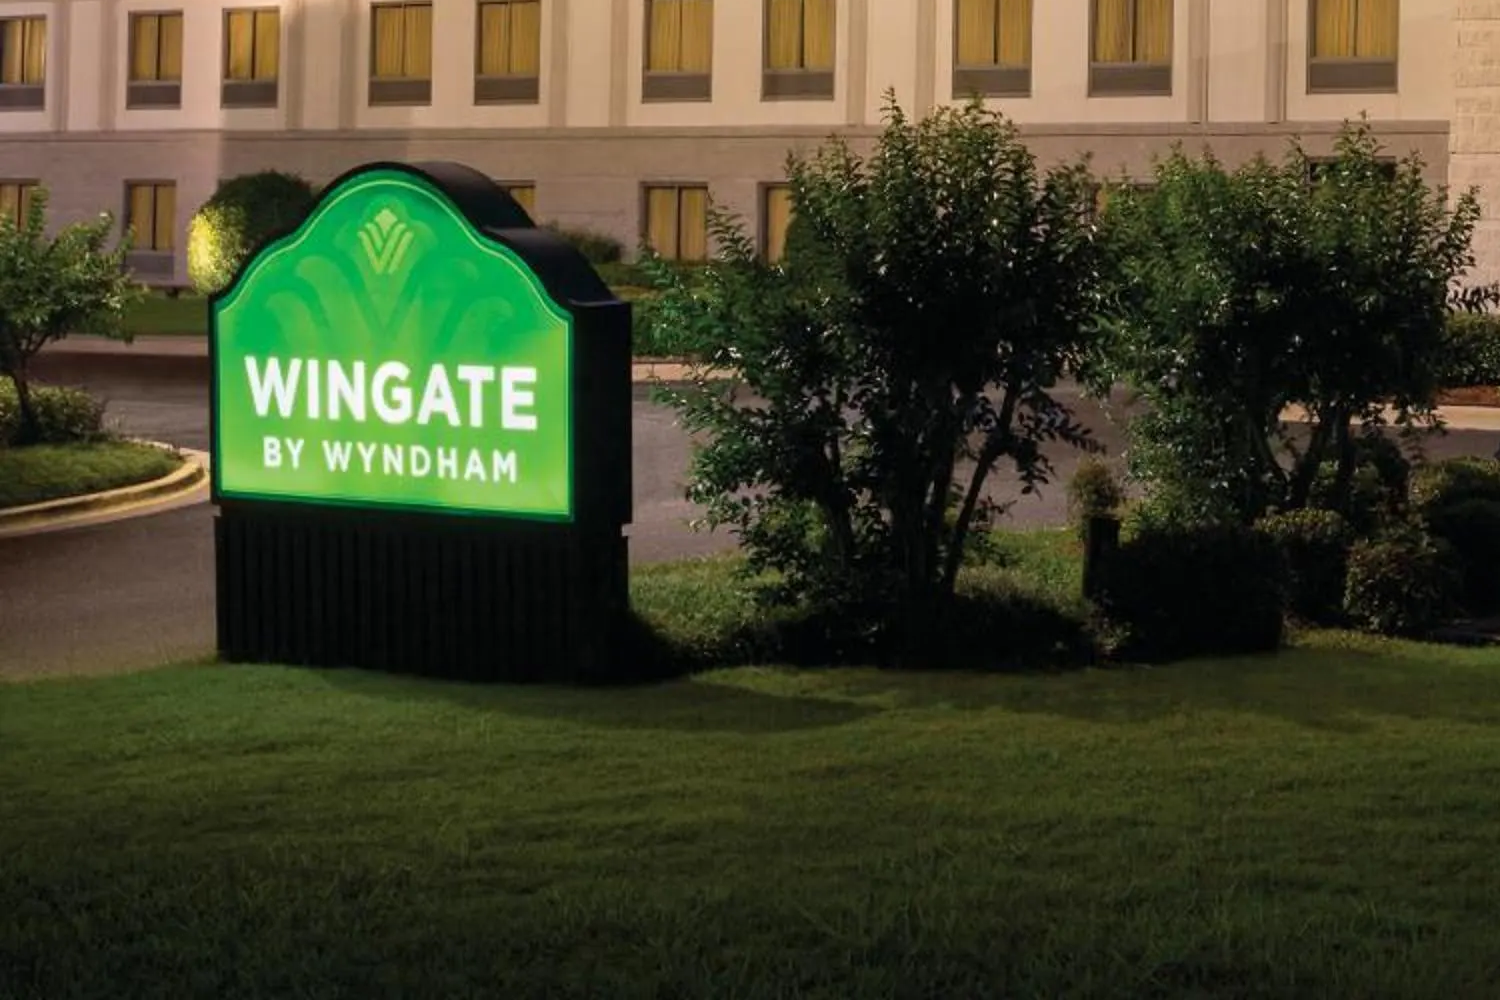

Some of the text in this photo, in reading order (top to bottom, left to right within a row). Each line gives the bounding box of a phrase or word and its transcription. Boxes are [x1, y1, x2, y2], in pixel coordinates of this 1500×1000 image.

[245, 356, 537, 430] WINGATE
[263, 437, 517, 483] BY WYNDHAM
